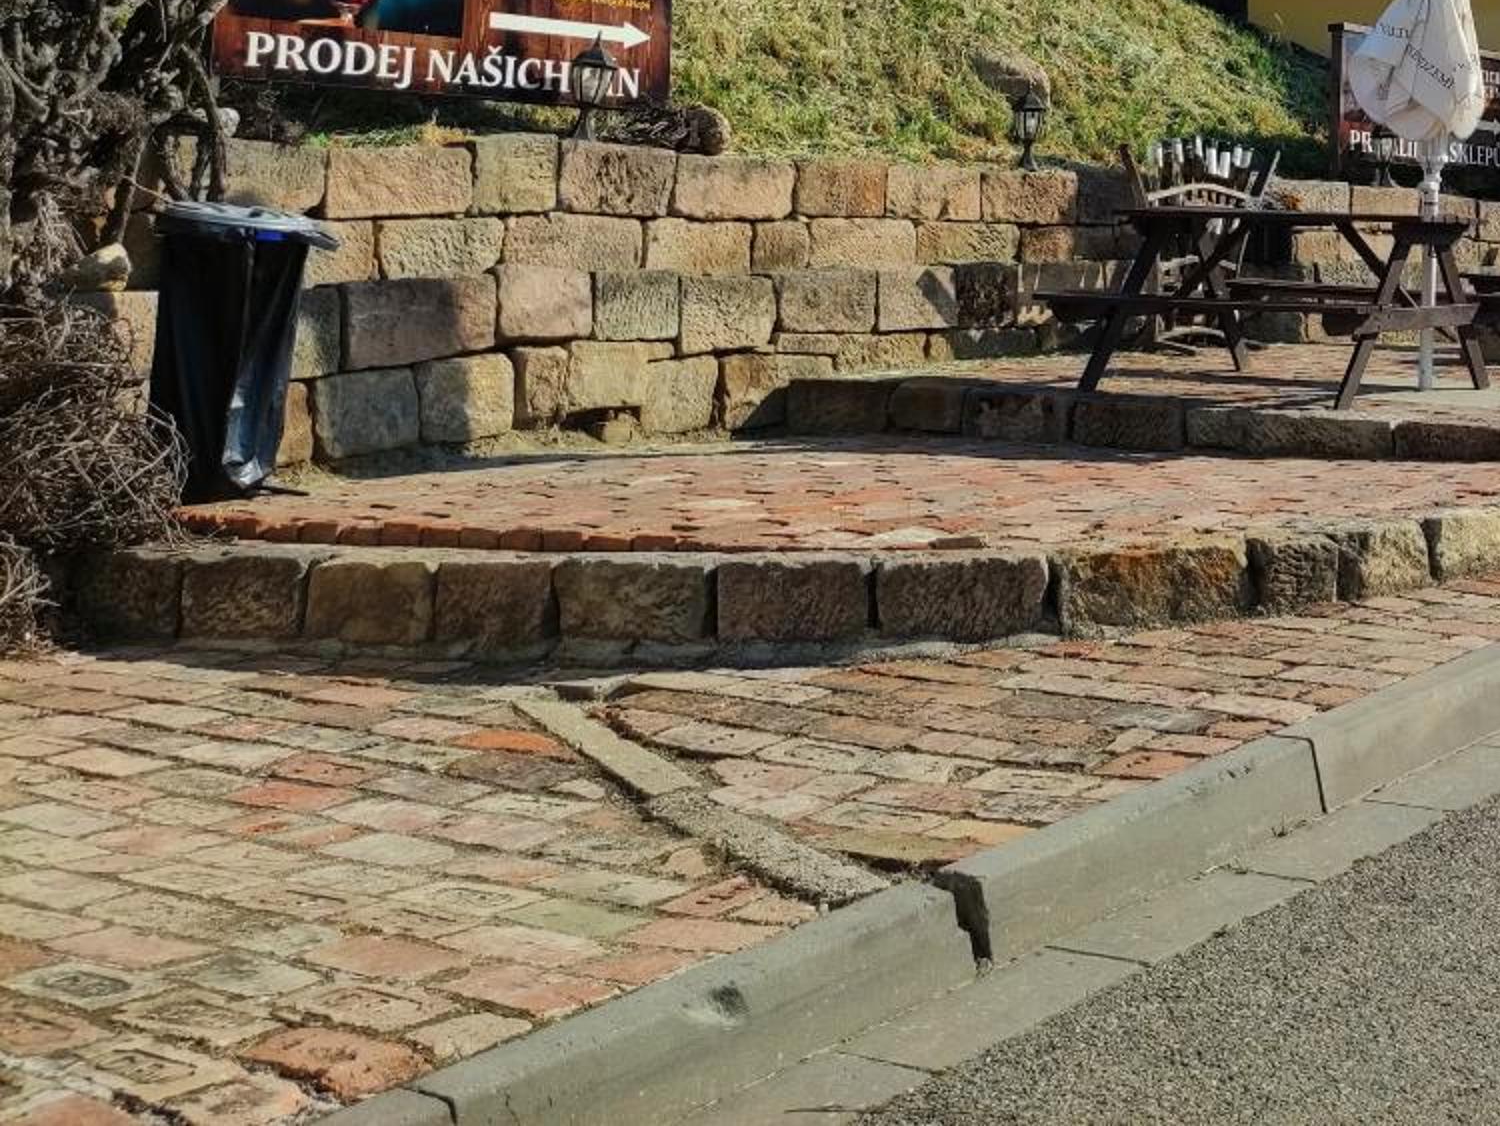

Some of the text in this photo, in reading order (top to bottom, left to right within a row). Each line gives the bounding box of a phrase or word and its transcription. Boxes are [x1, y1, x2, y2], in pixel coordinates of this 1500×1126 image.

[244, 31, 640, 98] PRODEJ NAŠICH ÍN
